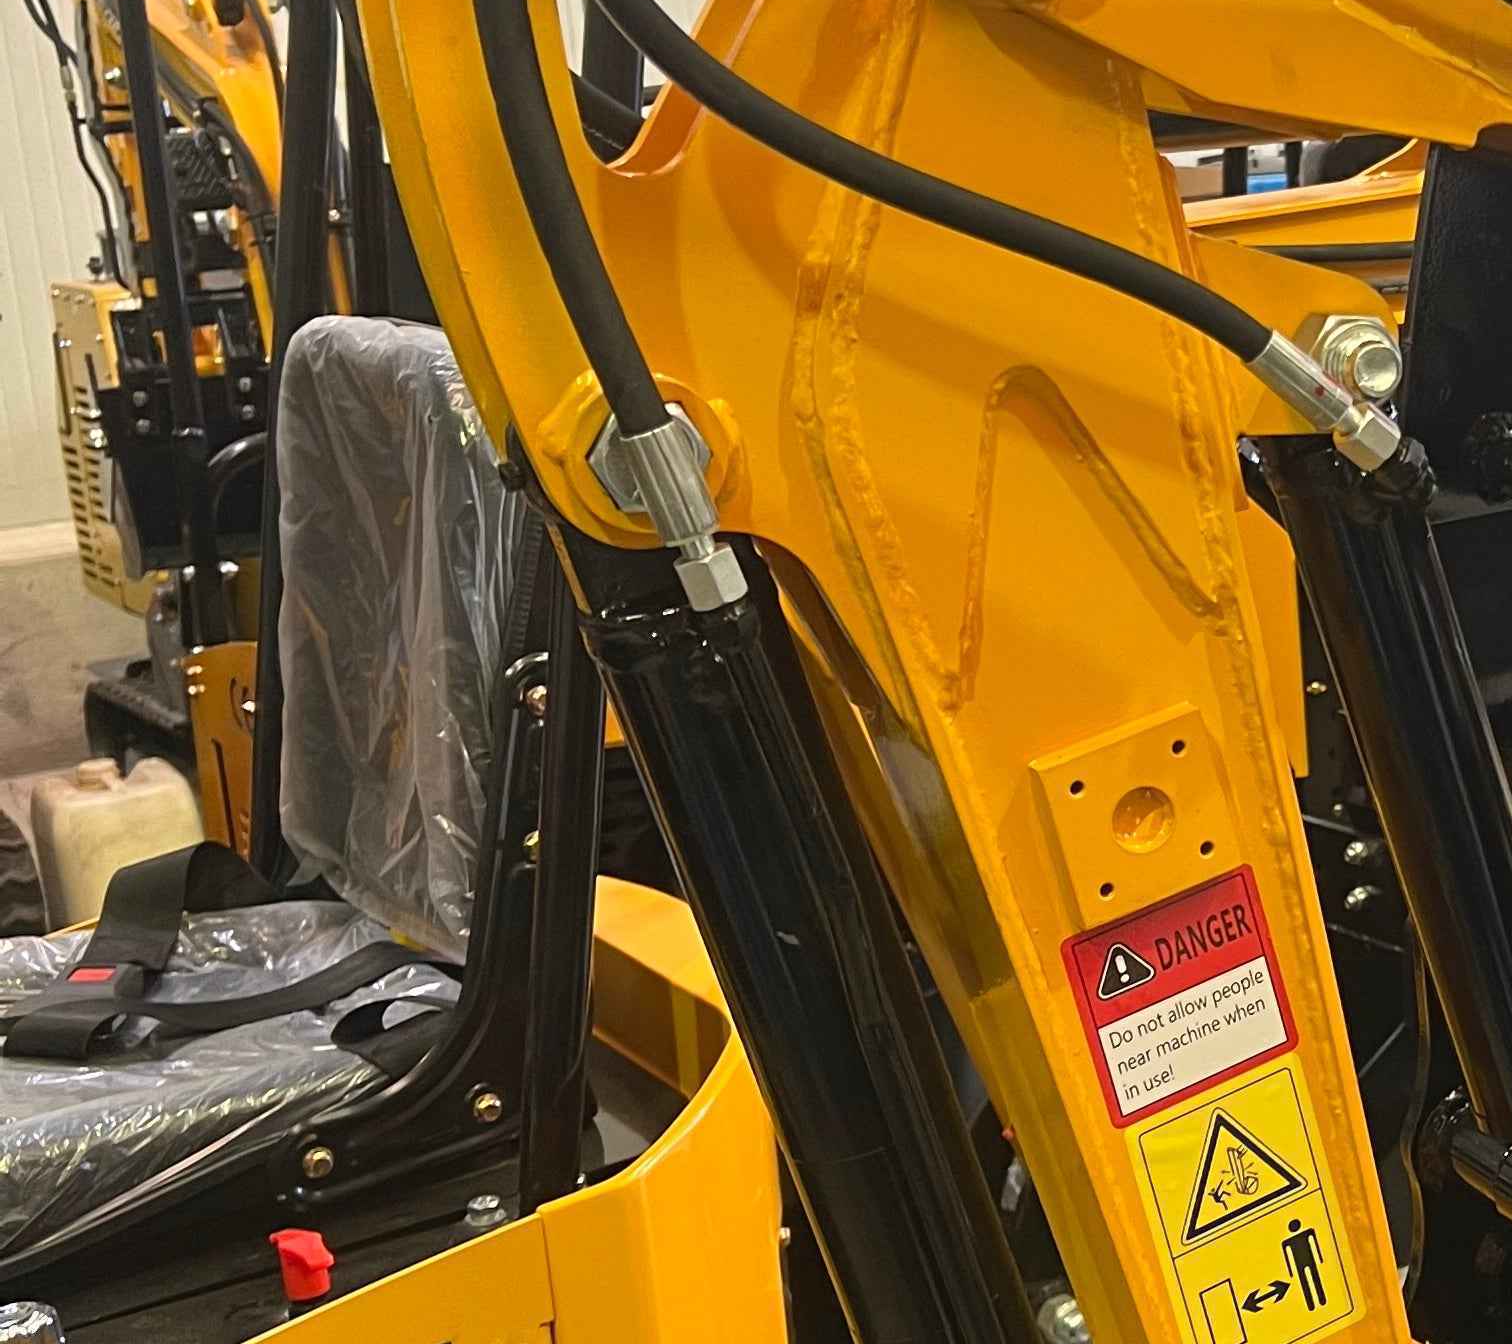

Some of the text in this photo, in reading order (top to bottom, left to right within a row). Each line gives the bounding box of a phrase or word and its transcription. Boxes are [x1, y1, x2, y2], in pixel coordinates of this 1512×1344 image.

[1155, 904, 1253, 971] DANGER
[1109, 969, 1264, 1049] Do not allow people
[1117, 998, 1266, 1075] near machine when
[1122, 1064, 1175, 1100] in use!
